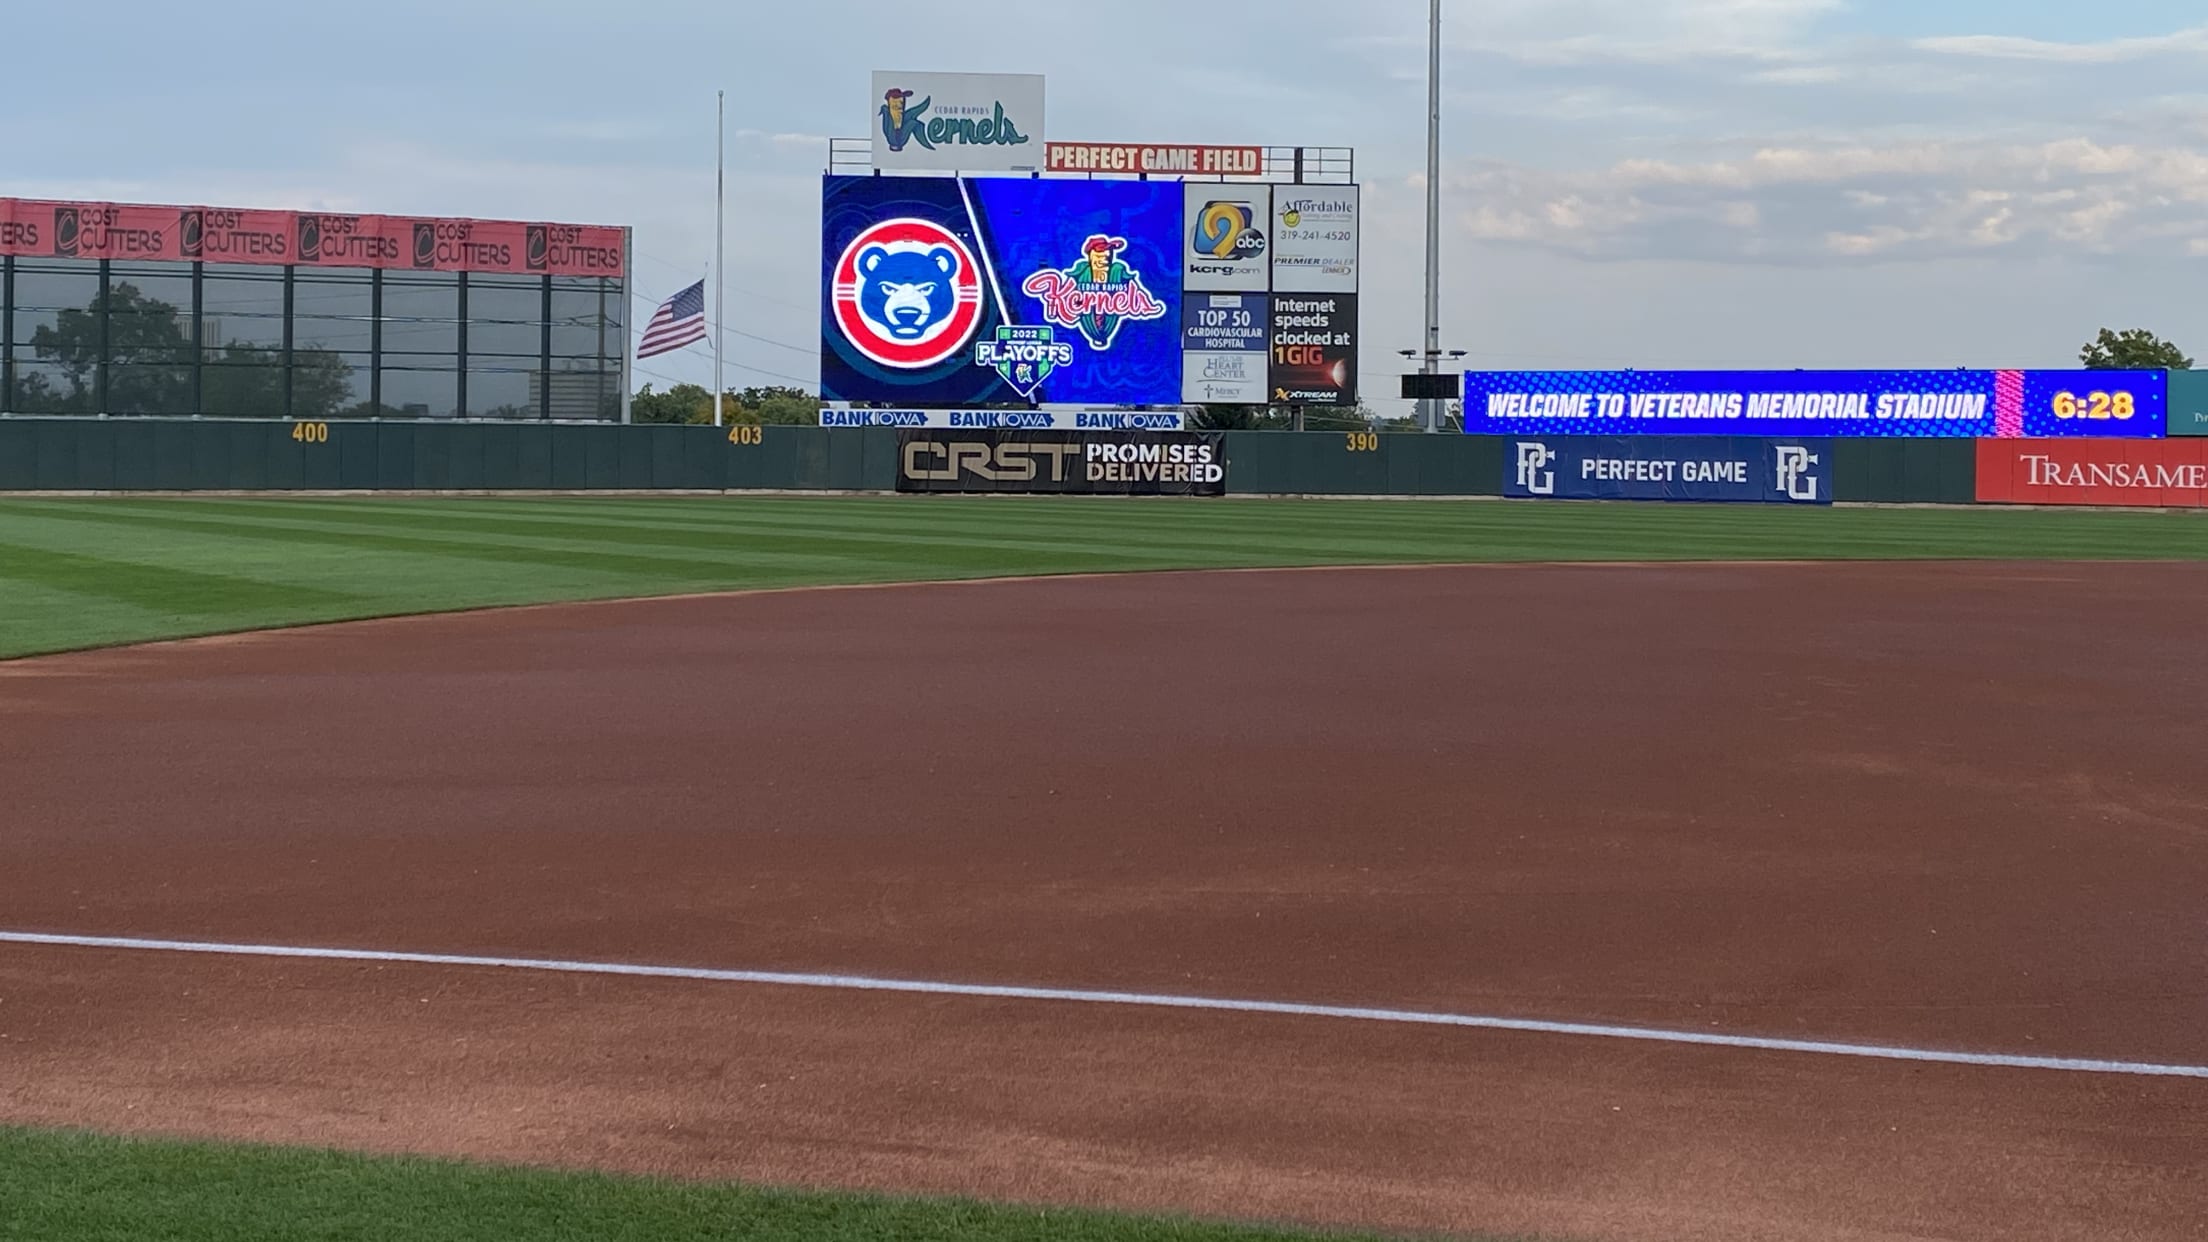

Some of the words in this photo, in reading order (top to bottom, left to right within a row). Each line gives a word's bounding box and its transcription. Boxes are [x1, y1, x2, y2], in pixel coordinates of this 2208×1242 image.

[934, 106, 959, 115] CEDAR
[961, 106, 990, 115] RAPIDS
[879, 95, 1029, 151] Kernels
[1051, 146, 1138, 170] PERFECT
[1141, 149, 1198, 171] GAME
[1202, 150, 1257, 171] FIELD
[1277, 199, 1353, 214] Affordable
[80, 208, 120, 226] COST
[204, 211, 243, 229] COST
[322, 216, 360, 234] COST
[80, 227, 163, 252] CUTTERS
[436, 223, 473, 240] COST
[549, 227, 583, 244] COST
[1280, 230, 1351, 241] 319-241-4520
[204, 231, 287, 255] CUTTERS
[321, 236, 399, 259] CUTTERS
[1236, 234, 1265, 249] abc
[436, 244, 511, 266] CUTTERS
[549, 246, 619, 270] CUTTERS
[1273, 257, 1321, 265] PREMIER
[1078, 283, 1100, 292] CEDAR
[1102, 283, 1128, 292] RAPIDS
[1026, 273, 1162, 325] Kernels
[1274, 298, 1336, 313] Internet
[1198, 310, 1227, 327] TOP
[1231, 310, 1251, 327] 50
[1274, 313, 1329, 330] speeds
[1012, 329, 1038, 339] 2022
[1187, 326, 1263, 338] CARDIOVASCULAR
[1274, 330, 1331, 345] clocked
[1334, 332, 1350, 345] at
[1205, 337, 1246, 349] HOSPITAL
[978, 344, 1071, 362] PLAYOFFS
[1275, 346, 1323, 365] 1GIG
[1207, 358, 1245, 369] HEART
[1203, 367, 1246, 379] CENTER
[1488, 393, 1592, 418] WELCOME
[1597, 393, 1627, 418] TO
[1630, 393, 1742, 418] VETERANS
[1746, 393, 1869, 419] MEMORIAL
[1875, 393, 1986, 419] STADIUM
[2053, 391, 2135, 419] 6:28
[292, 423, 328, 443] 400
[728, 427, 763, 445] 403
[1346, 433, 1378, 451] 390
[904, 441, 1081, 481] CRST
[1087, 443, 1211, 463] PROMISES
[1087, 463, 1223, 483] DELIVERED
[1581, 458, 1677, 481] PERFECT
[1682, 461, 1748, 483] GAME
[2020, 454, 2208, 488] TRANSAME
